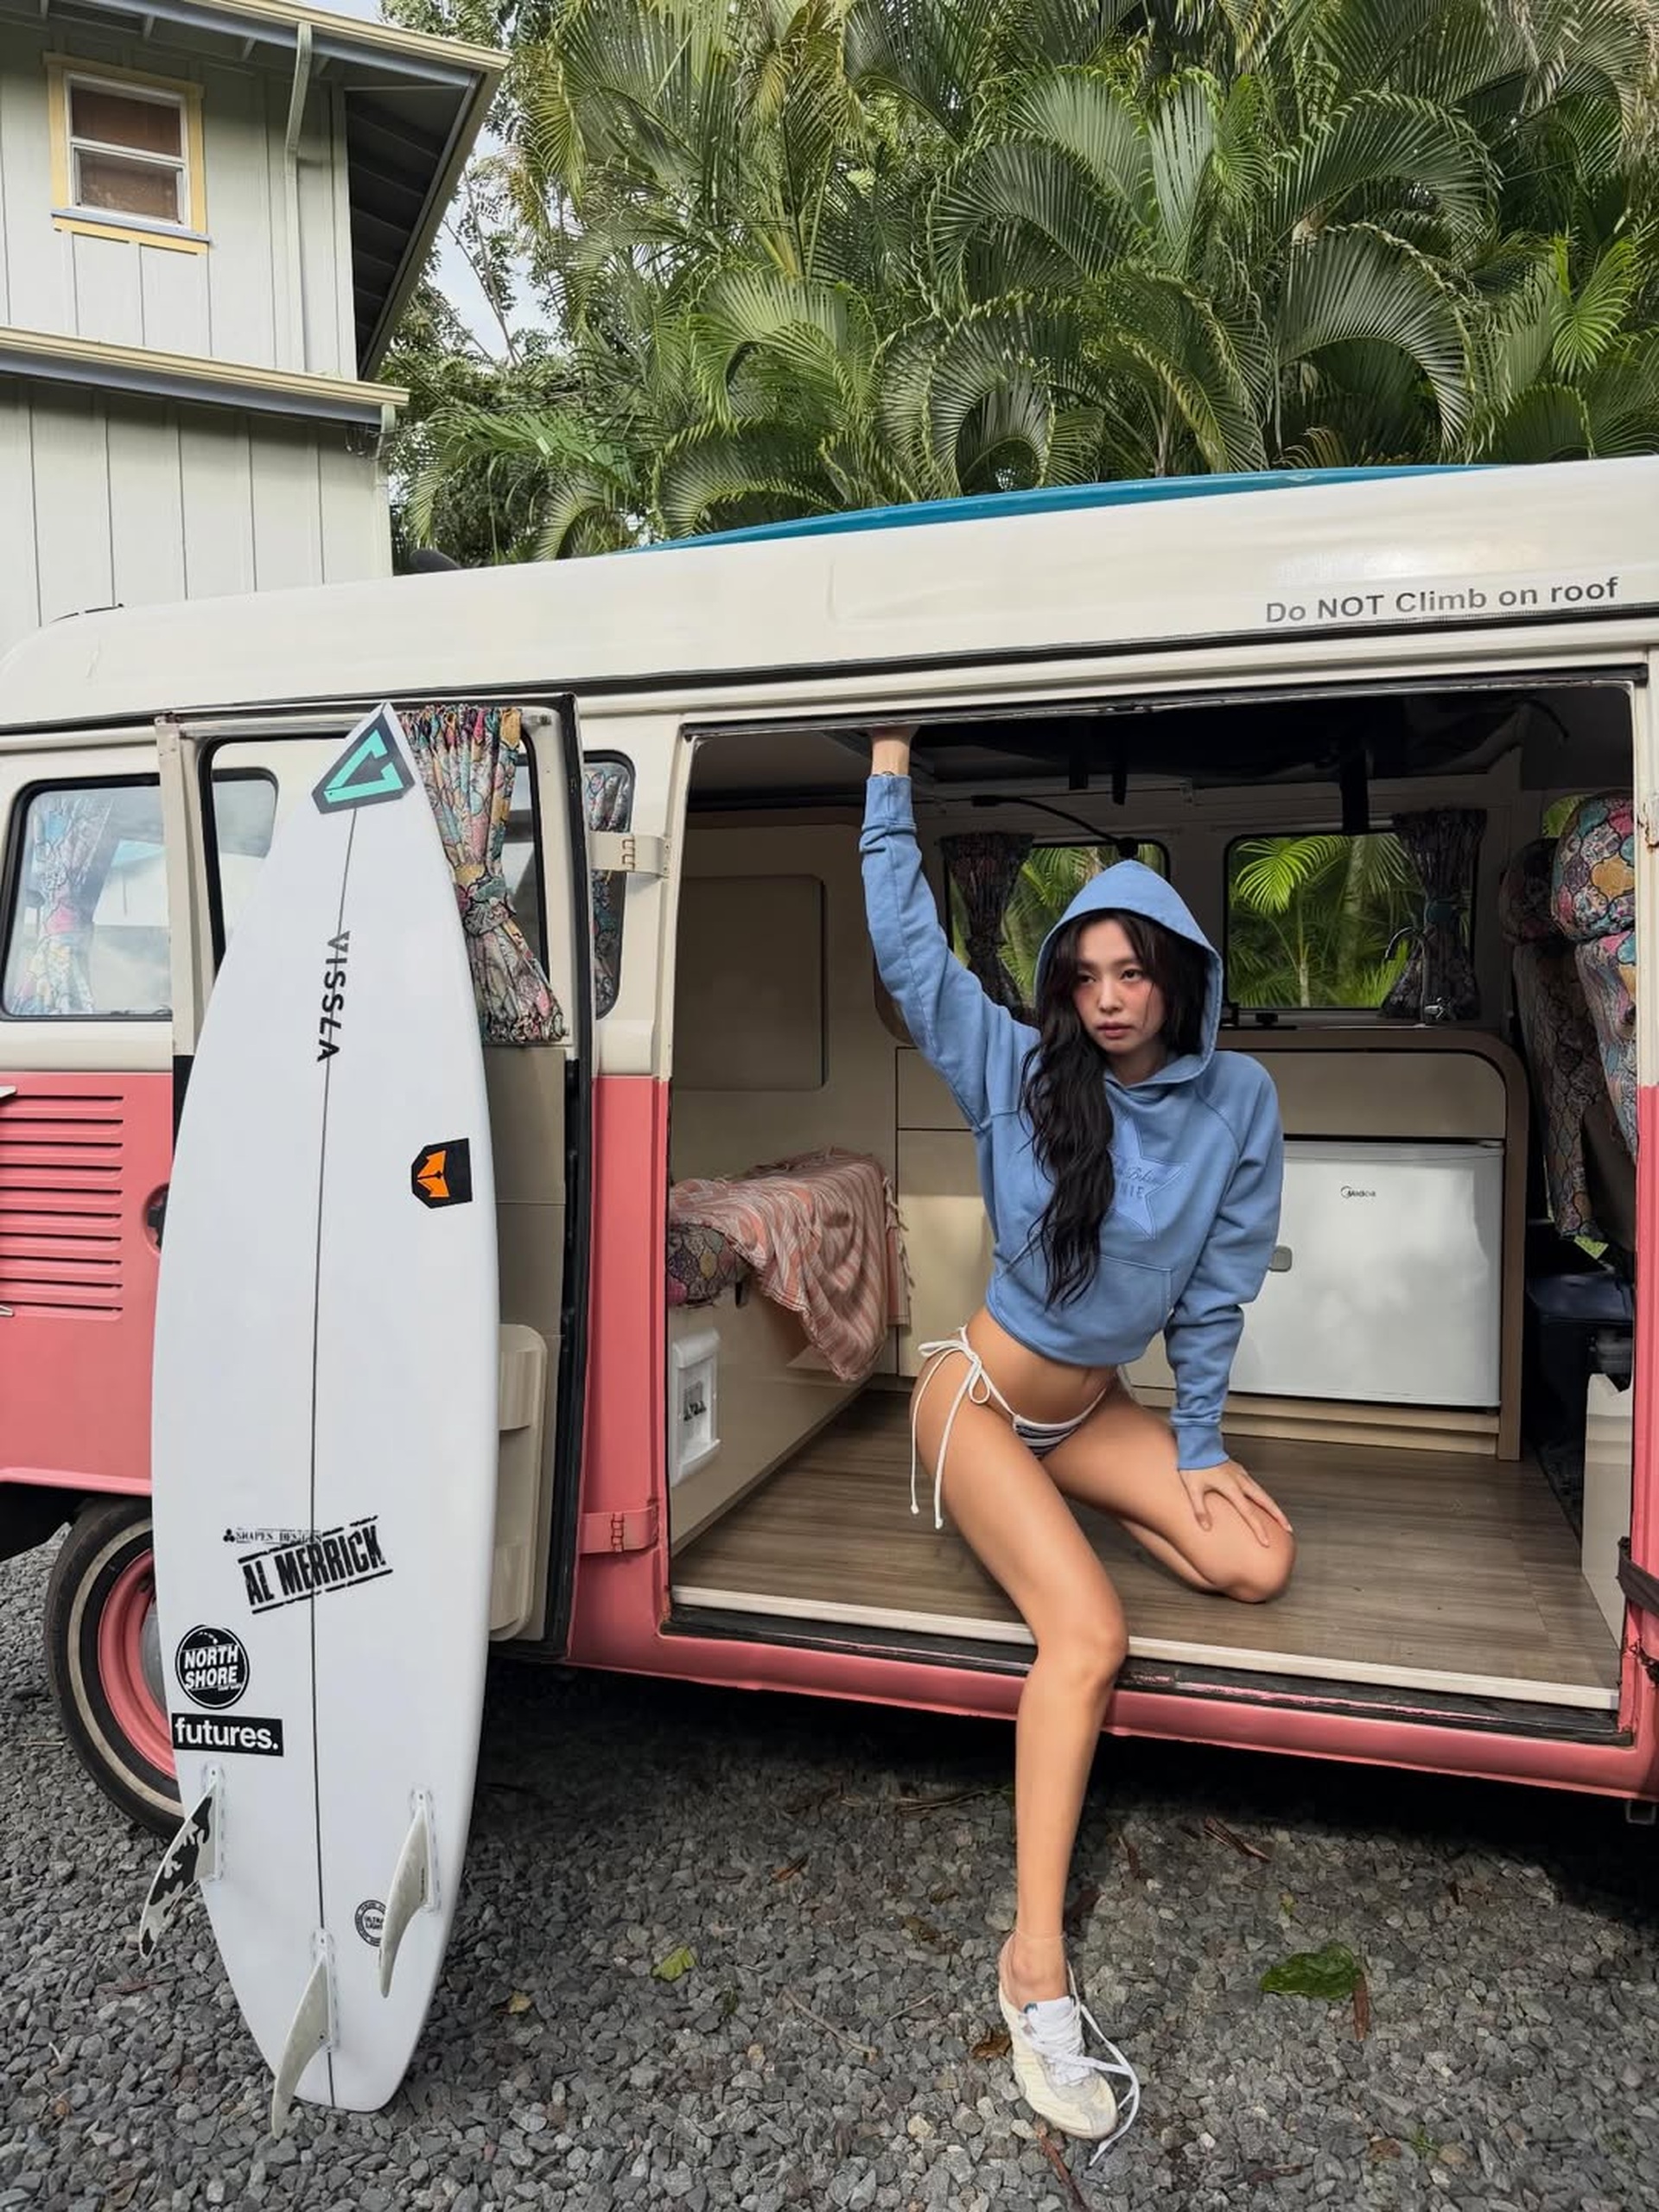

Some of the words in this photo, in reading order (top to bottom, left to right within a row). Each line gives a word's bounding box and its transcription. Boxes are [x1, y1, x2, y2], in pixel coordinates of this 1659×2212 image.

[1266, 602, 1306, 622] Do
[1318, 594, 1384, 619] NOT
[1395, 588, 1487, 613] Climb
[1498, 588, 1538, 606] on
[1551, 576, 1619, 603] roof
[317, 931, 350, 1062] VISSLA
[243, 1560, 275, 1606] AL
[274, 1525, 387, 1597] MERRICK
[184, 1645, 238, 1669] NORTH
[184, 1665, 238, 1690] SHORE
[175, 1717, 279, 1750] futures.
